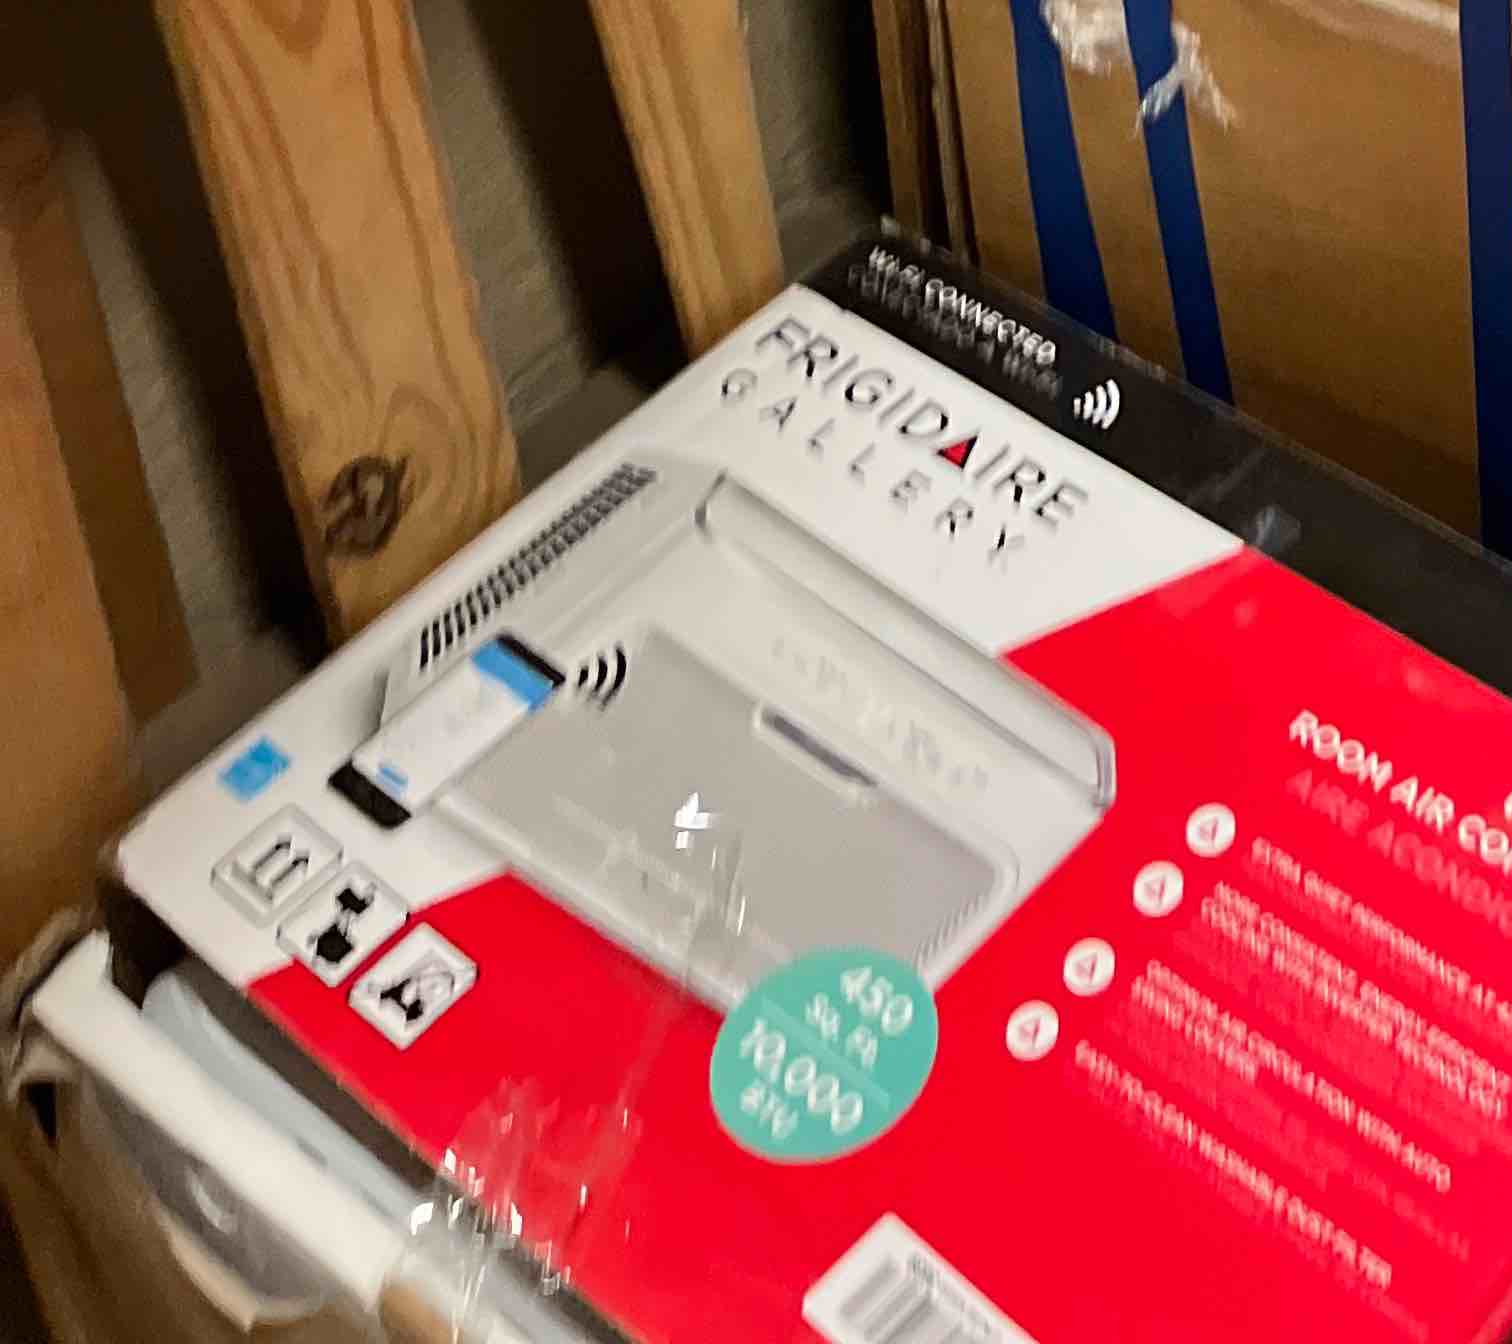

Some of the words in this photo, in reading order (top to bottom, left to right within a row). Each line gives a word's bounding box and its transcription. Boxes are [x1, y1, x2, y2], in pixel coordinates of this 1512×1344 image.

[924, 277, 1057, 365] CONNECTED
[719, 366, 1026, 570] GALLERY
[755, 316, 1089, 529] FRIGIDAIRE
[1289, 708, 1394, 794] ROOM
[1388, 773, 1456, 834] AIR
[839, 965, 914, 1037] 450
